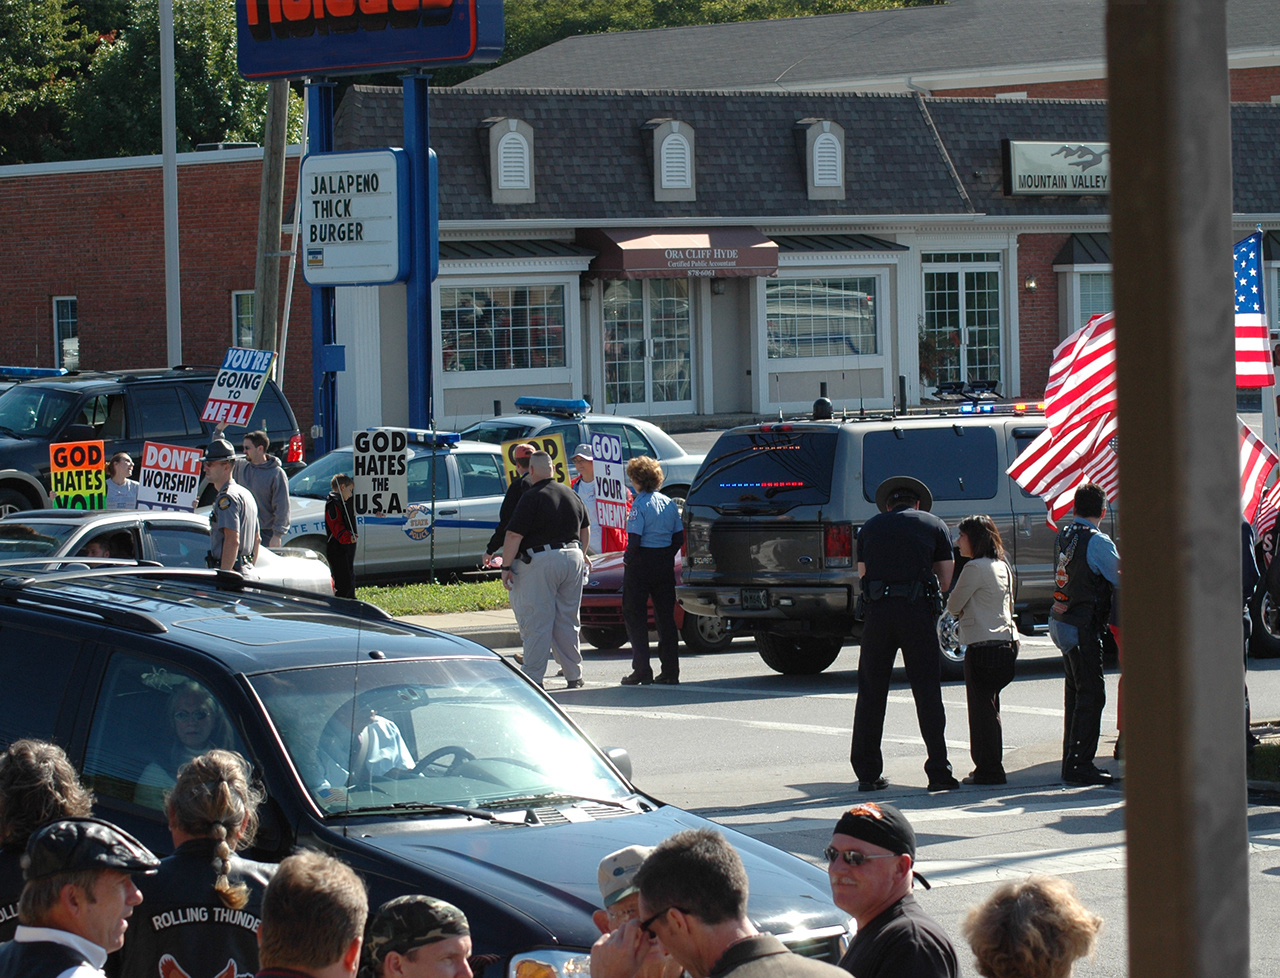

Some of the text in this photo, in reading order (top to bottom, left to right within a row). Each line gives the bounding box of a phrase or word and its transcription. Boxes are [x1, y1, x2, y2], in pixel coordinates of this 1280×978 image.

[311, 173, 379, 195] JALAPENO
[1018, 174, 1107, 188] MOUNTAIN VALLEY
[312, 199, 352, 218] THICK
[310, 222, 363, 242] BURGER
[664, 248, 738, 259] ORA CLIFF HYDE
[224, 350, 272, 371] YOU'RE
[217, 371, 262, 390] GOING
[228, 390, 241, 400] TO
[202, 400, 248, 424] HELL
[354, 432, 406, 453] GOD
[592, 434, 620, 461] GOD
[54, 445, 102, 468] GOD
[146, 446, 200, 472] DON'T
[354, 454, 406, 476] HATES
[54, 470, 103, 492] HATES
[605, 464, 610, 476] IS
[142, 469, 197, 494] WORSHIP
[372, 477, 390, 492] THE
[596, 476, 622, 500] YOUR
[157, 492, 178, 504] THE
[355, 492, 406, 515] U.S.A.
[596, 502, 626, 529] ENEMY
[152, 907, 208, 930] ROLLING
[213, 908, 262, 933] THUNDE
